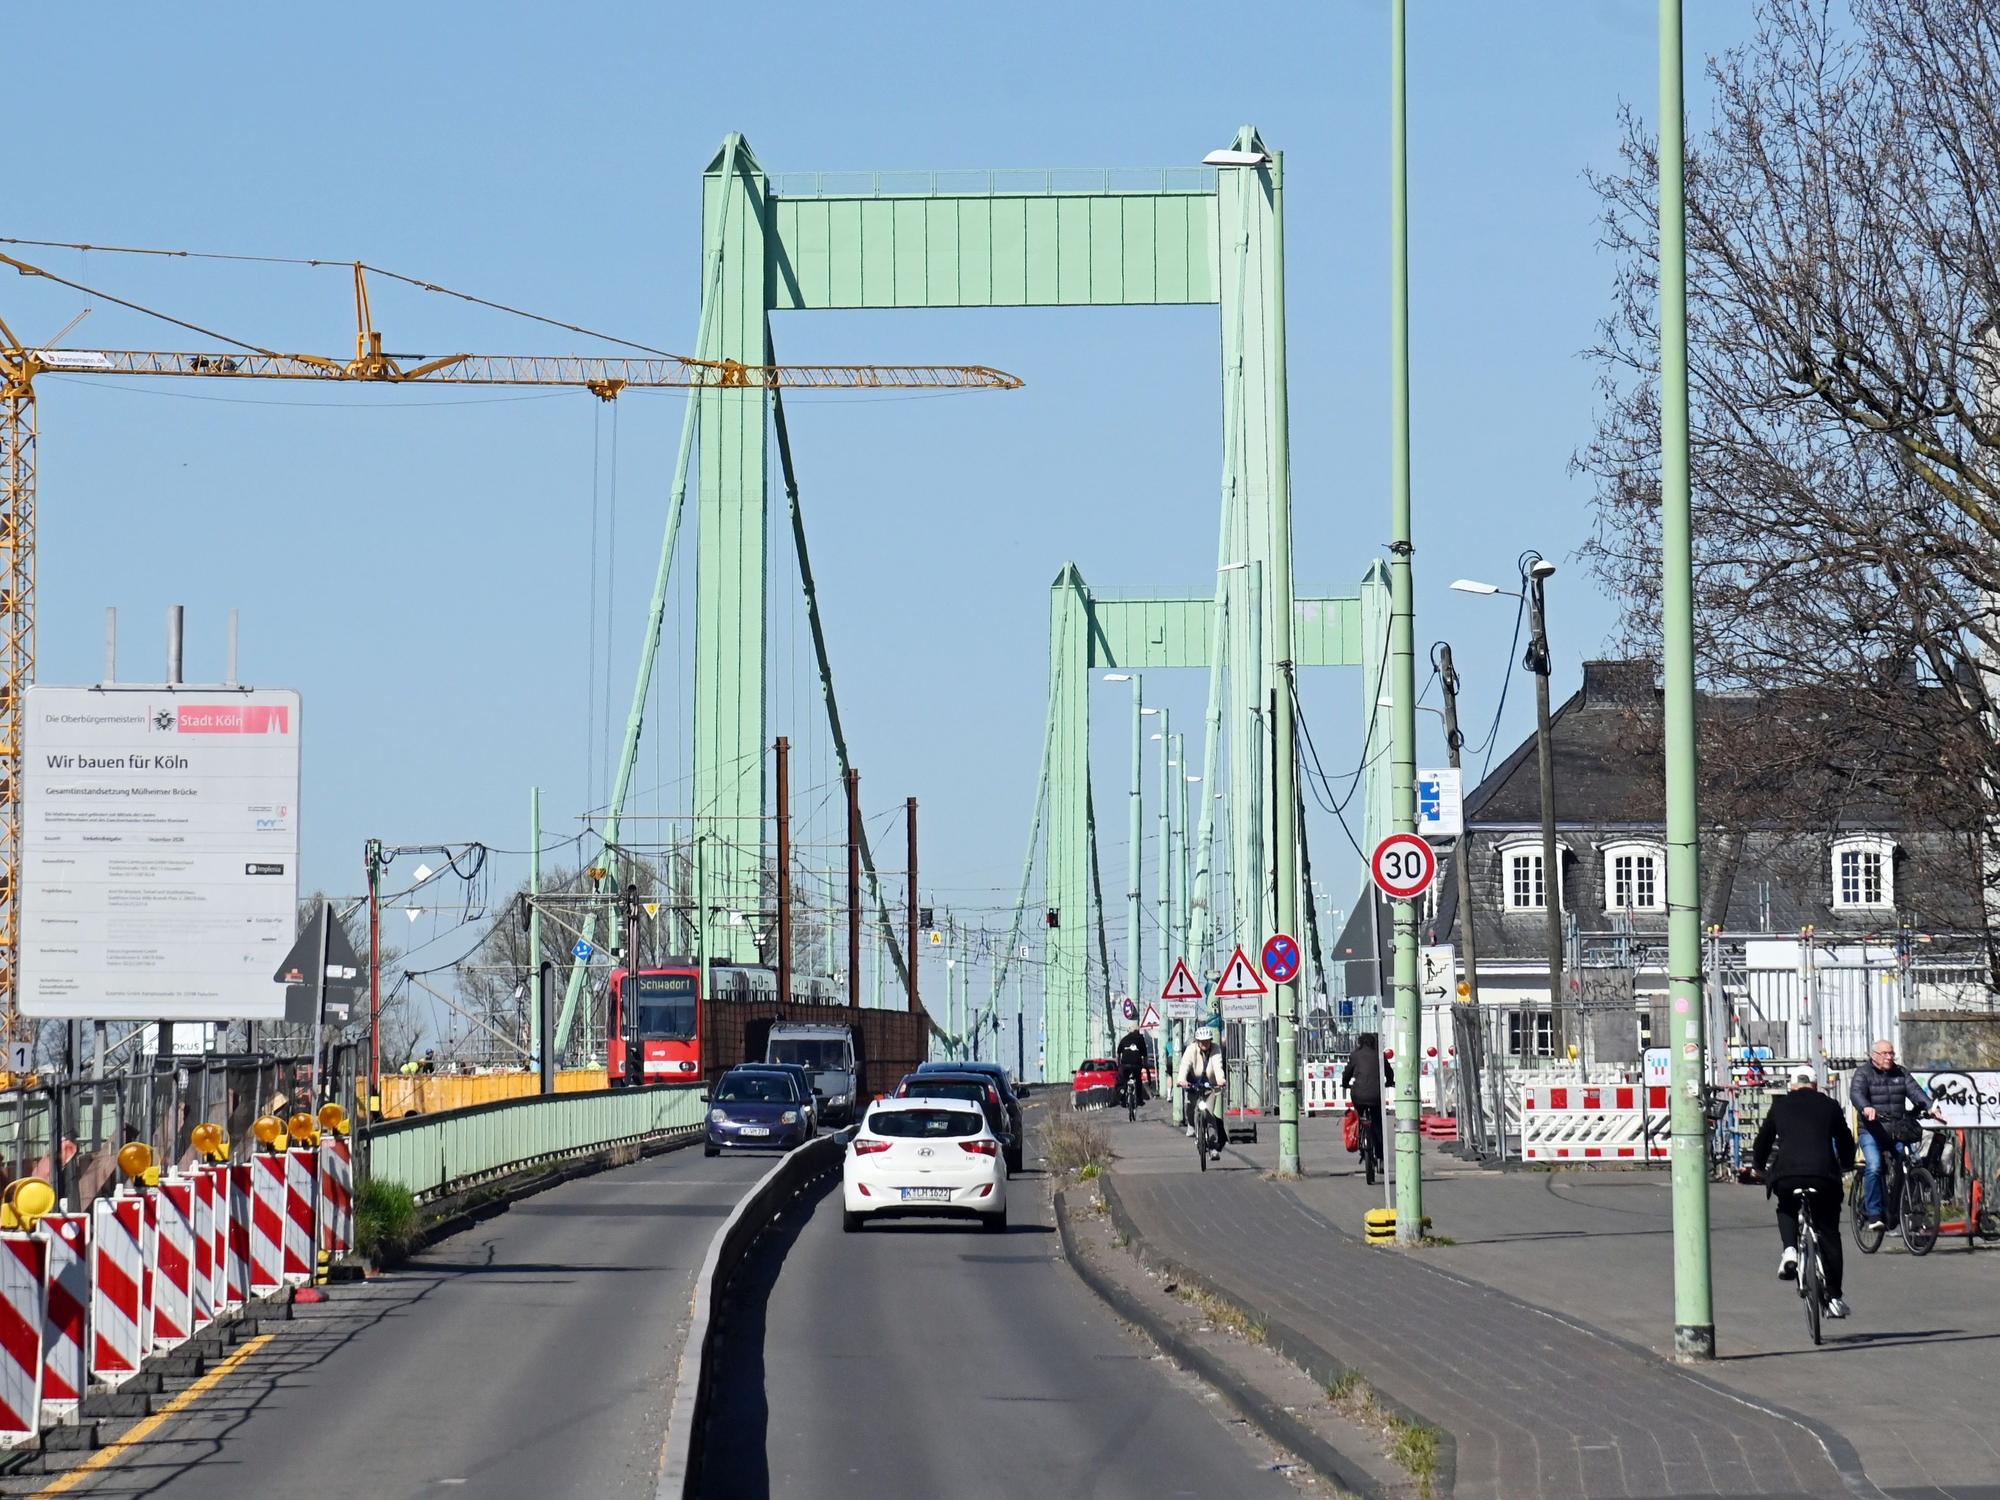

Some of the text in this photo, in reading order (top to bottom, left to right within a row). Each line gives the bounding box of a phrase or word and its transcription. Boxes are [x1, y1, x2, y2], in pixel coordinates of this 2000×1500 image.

[46, 713, 244, 727] Die Oberbürgermeisterin Stadt Köln
[47, 753, 189, 769] Wir bauen für Köln
[45, 787, 130, 797] Gesamtinstandsetzung
[172, 788, 198, 796] Brücke
[1385, 851, 1421, 879] 30
[932, 934, 940, 944] A
[1021, 947, 1028, 957] E
[16, 1047, 25, 1067] 1
